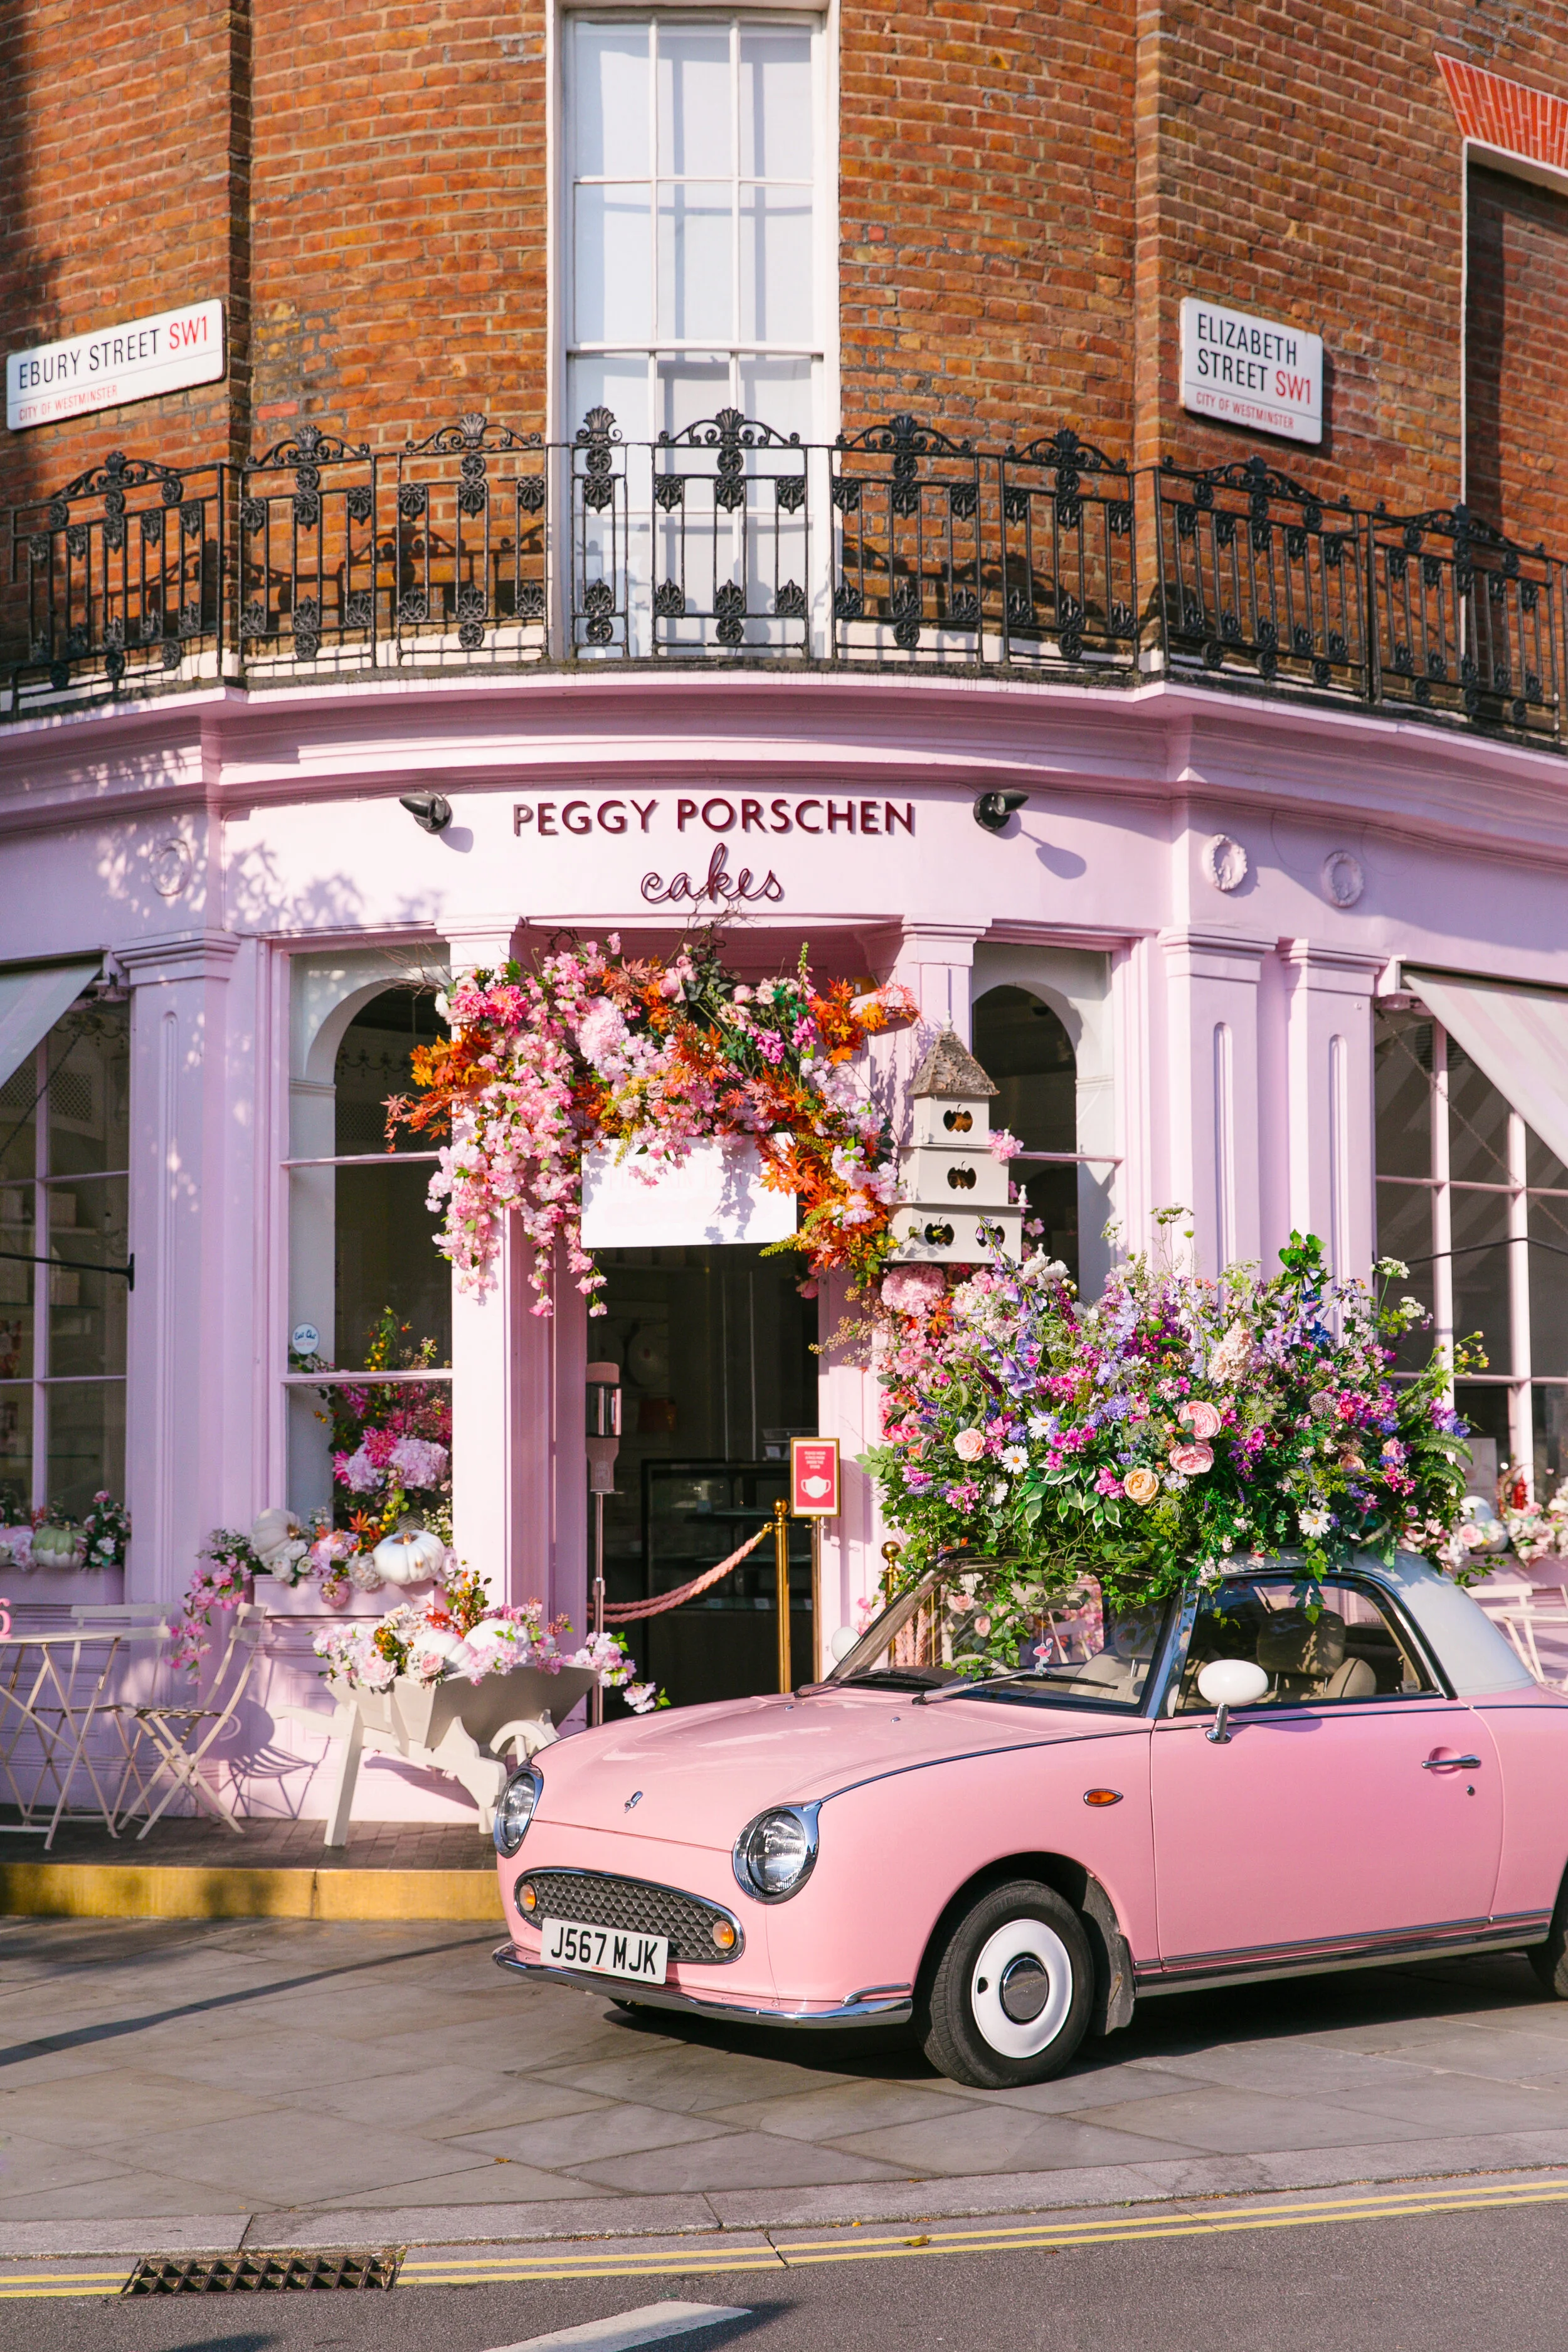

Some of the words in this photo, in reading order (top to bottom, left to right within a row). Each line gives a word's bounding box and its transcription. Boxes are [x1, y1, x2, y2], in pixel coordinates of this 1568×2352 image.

[19, 349, 81, 390] EBURY
[89, 328, 161, 371] STREET
[169, 315, 208, 350] SW1
[1197, 312, 1296, 366] ELIZABETH
[1197, 348, 1268, 391] STREET
[1275, 370, 1311, 405] SW1
[19, 406, 38, 421] CITY
[41, 402, 52, 414] OF
[55, 384, 118, 410] WESTMINSTER
[1196, 391, 1216, 408] CITY
[1219, 398, 1230, 411] OF
[1232, 401, 1295, 429] WESTMINSTER
[513, 799, 658, 836] PEGGY
[677, 798, 915, 836] PORSCHEN
[640, 842, 783, 902] cakes
[551, 1927, 607, 1965] J567
[613, 1936, 658, 1975] MJK
